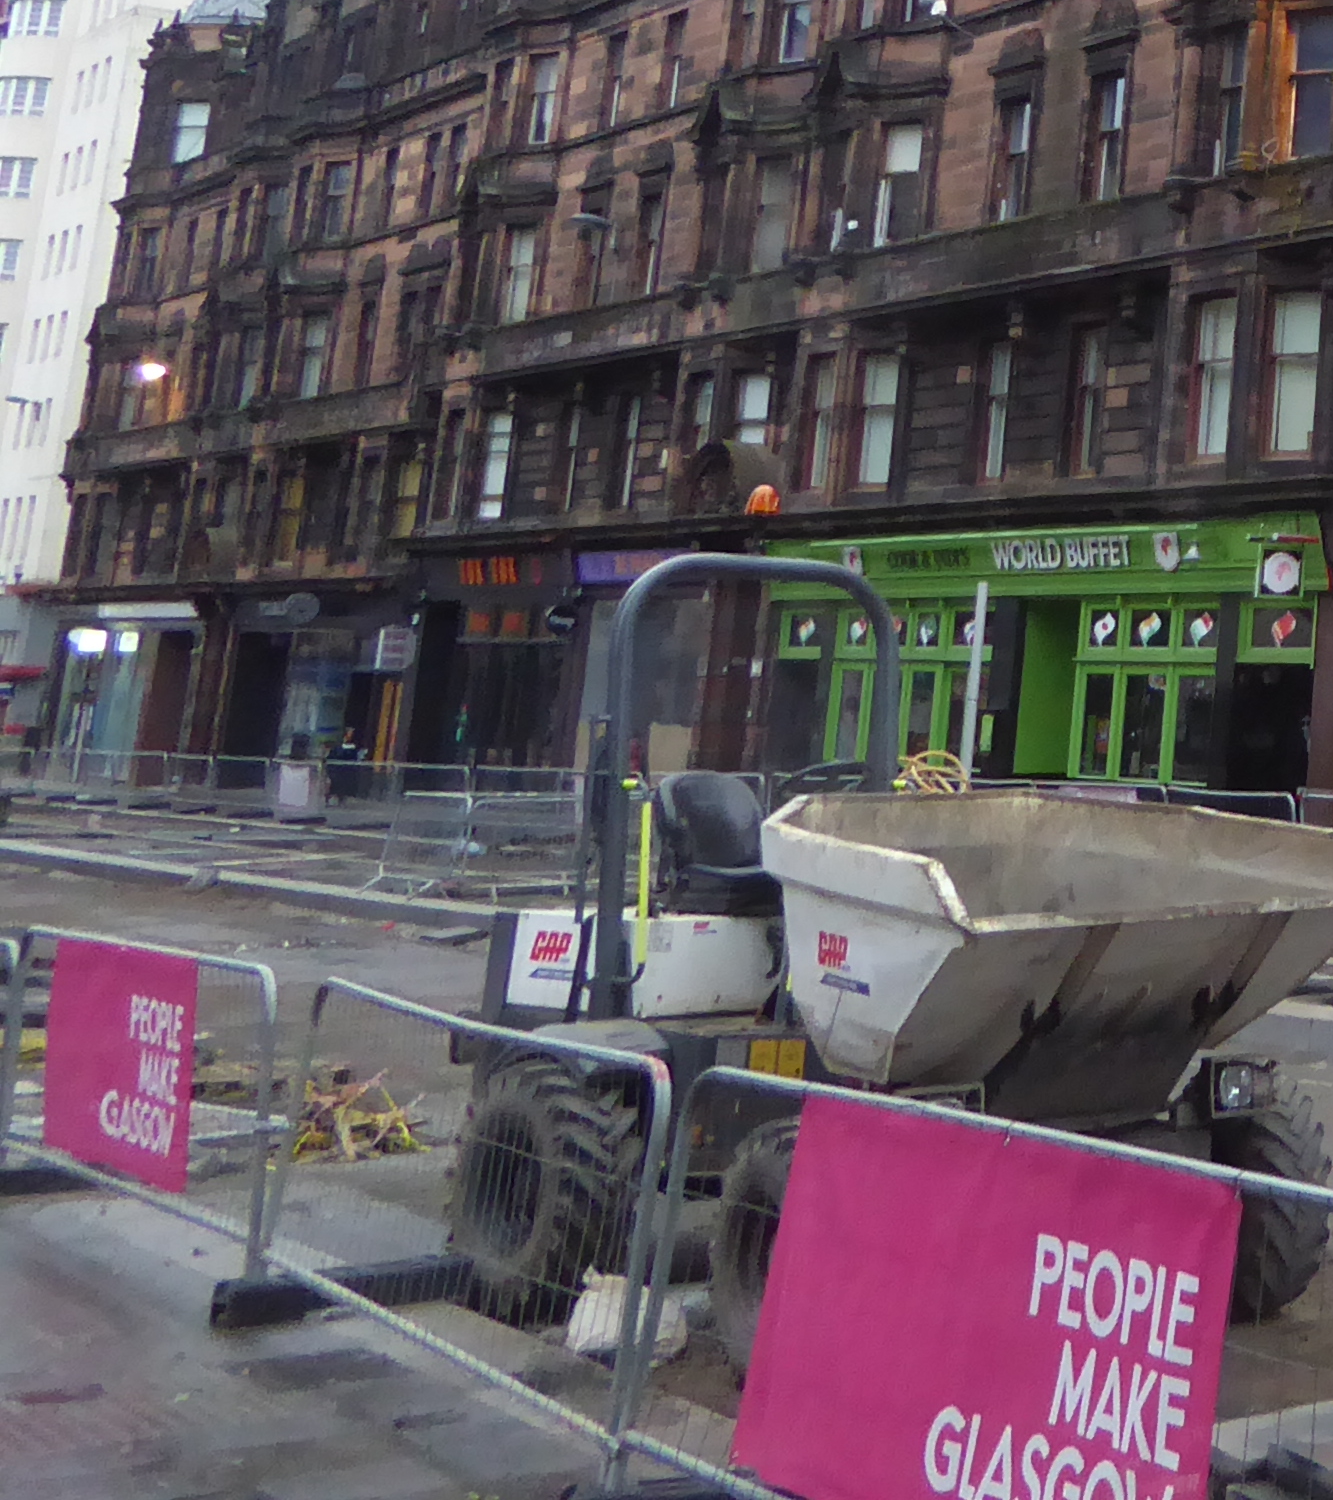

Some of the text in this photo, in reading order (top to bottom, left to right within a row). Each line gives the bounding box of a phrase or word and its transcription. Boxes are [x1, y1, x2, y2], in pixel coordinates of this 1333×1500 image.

[991, 537, 1062, 570] WORLD
[1065, 534, 1131, 568] BUFFET
[130, 993, 184, 1052] PEOPLE
[138, 1048, 180, 1106] MAKE
[1028, 1232, 1200, 1366] PEOPLE
[1048, 1339, 1191, 1472] MAKE
[923, 1404, 1174, 1500] GLASG
